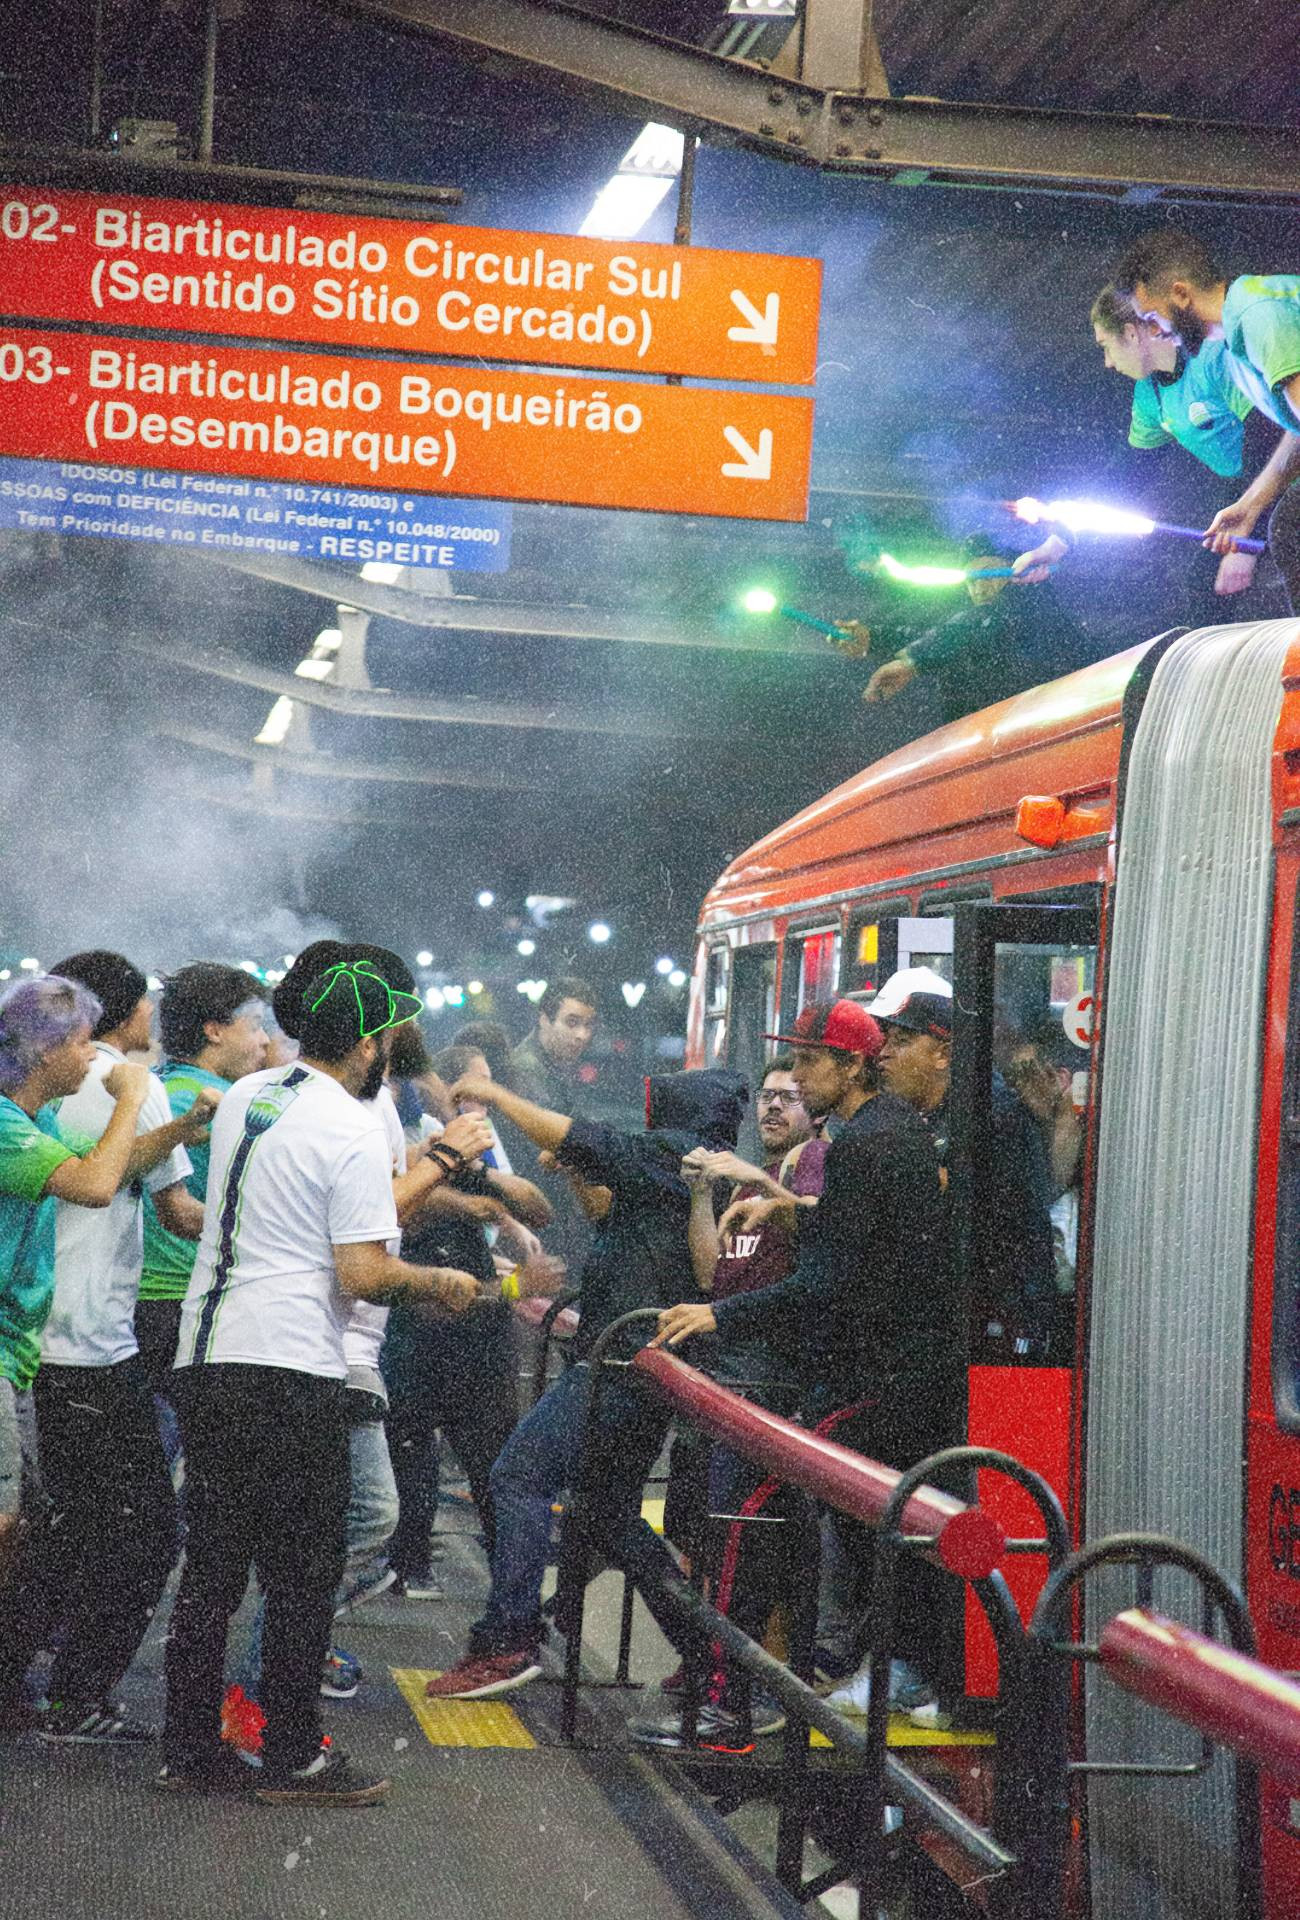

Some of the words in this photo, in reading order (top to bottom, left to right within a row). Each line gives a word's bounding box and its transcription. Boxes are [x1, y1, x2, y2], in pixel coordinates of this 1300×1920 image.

[2, 201, 76, 243] 02-
[95, 208, 388, 272] Biarticulado
[405, 237, 593, 290] Circular
[608, 256, 681, 300] Sul
[91, 260, 295, 315] (Sentido
[313, 278, 420, 327] Sítio
[437, 291, 652, 357] Cercado)
[0, 344, 71, 384] 03-
[89, 350, 381, 411] Biarticulado
[400, 375, 642, 433] Boqueirão
[86, 400, 457, 477] (Desembarque)
[61, 464, 137, 485] IDOSOS
[143, 473, 176, 489] (Lei
[182, 476, 249, 497] Federal
[285, 488, 398, 513] 10.741/2003)
[403, 501, 414, 512] e
[72, 491, 112, 506] com
[117, 494, 240, 519] DEFICIÊNCIA
[246, 507, 279, 524] (Lei
[285, 511, 352, 530] Federal
[387, 520, 499, 545] 10.048/2000)
[16, 510, 56, 528] Tem
[62, 515, 165, 539] Prioridade
[172, 529, 196, 541] no
[202, 530, 300, 553] Embarque
[320, 536, 455, 565] RESPEITE
